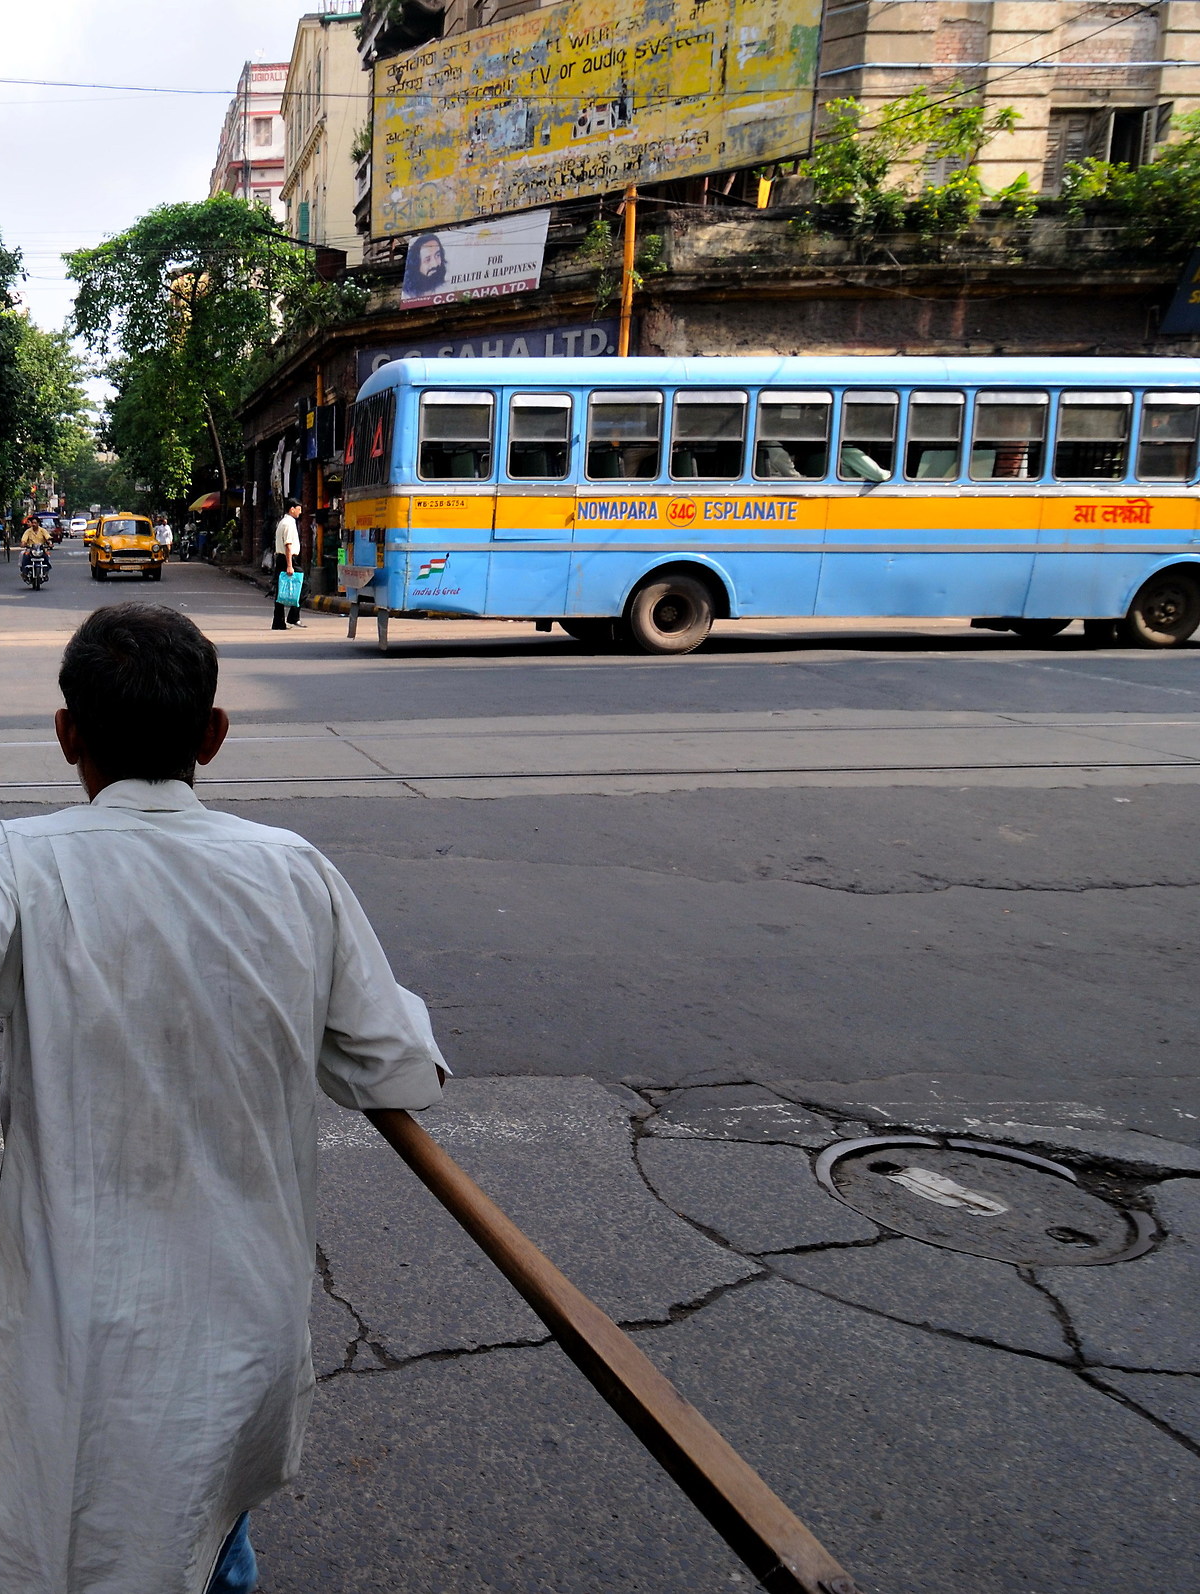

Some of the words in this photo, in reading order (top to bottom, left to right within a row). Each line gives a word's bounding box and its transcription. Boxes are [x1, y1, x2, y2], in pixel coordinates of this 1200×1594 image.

[559, 62, 576, 80] or
[582, 47, 628, 74] audio
[487, 254, 503, 266] FOR
[450, 272, 483, 285] HEALTH
[483, 269, 490, 279] &
[492, 261, 537, 278] HAPPINESS
[433, 291, 458, 306] C.C.
[462, 283, 500, 301] SAHA
[502, 281, 530, 296] LTD.
[545, 328, 616, 357] LTD.
[577, 501, 659, 520] NOWAPARA
[668, 502, 696, 520] 34C
[704, 501, 798, 521] ESPLANATE
[1073, 504, 1098, 524] মা
[412, 587, 432, 596] India
[442, 587, 461, 596] Great
